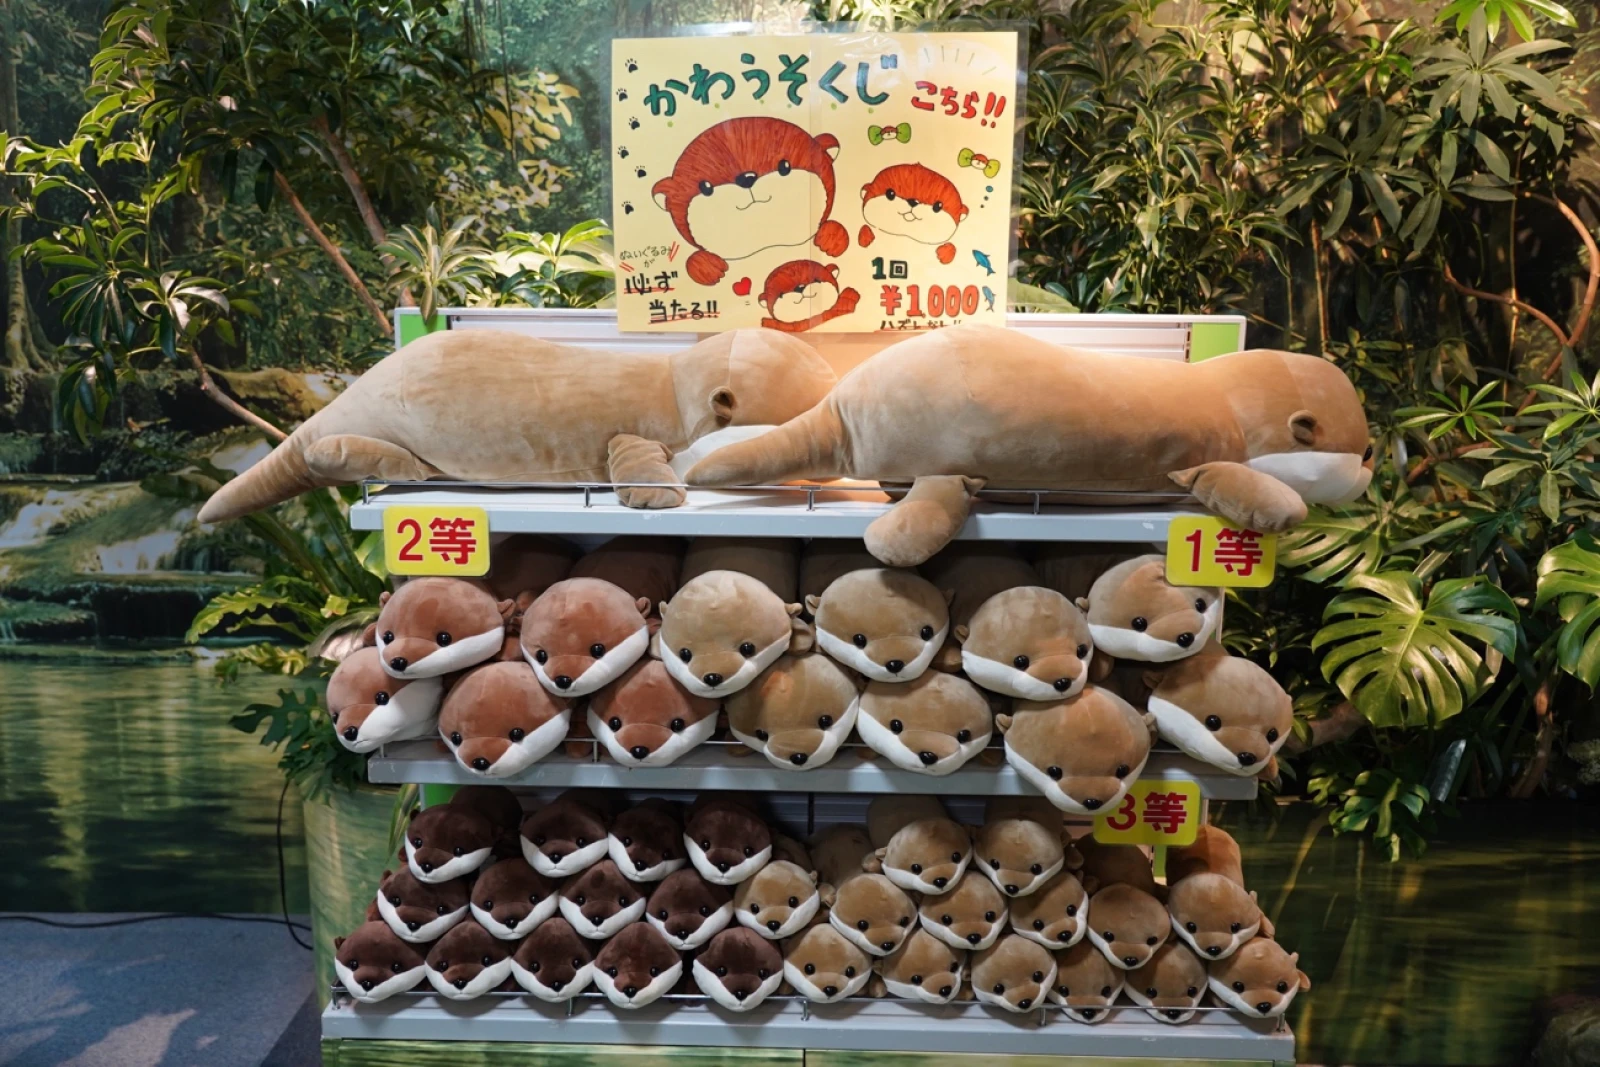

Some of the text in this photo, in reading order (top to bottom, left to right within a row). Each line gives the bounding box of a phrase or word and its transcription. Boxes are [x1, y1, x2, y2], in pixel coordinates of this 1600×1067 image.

[644, 53, 898, 116] かわうそくじ
[620, 245, 672, 261] ぬいぐるみ
[643, 258, 656, 269] が
[871, 256, 908, 280] 1回
[625, 270, 678, 295] 必ず
[397, 517, 477, 565] 2等
[1185, 528, 1263, 576] 1等
[1106, 792, 1187, 834] 3等
